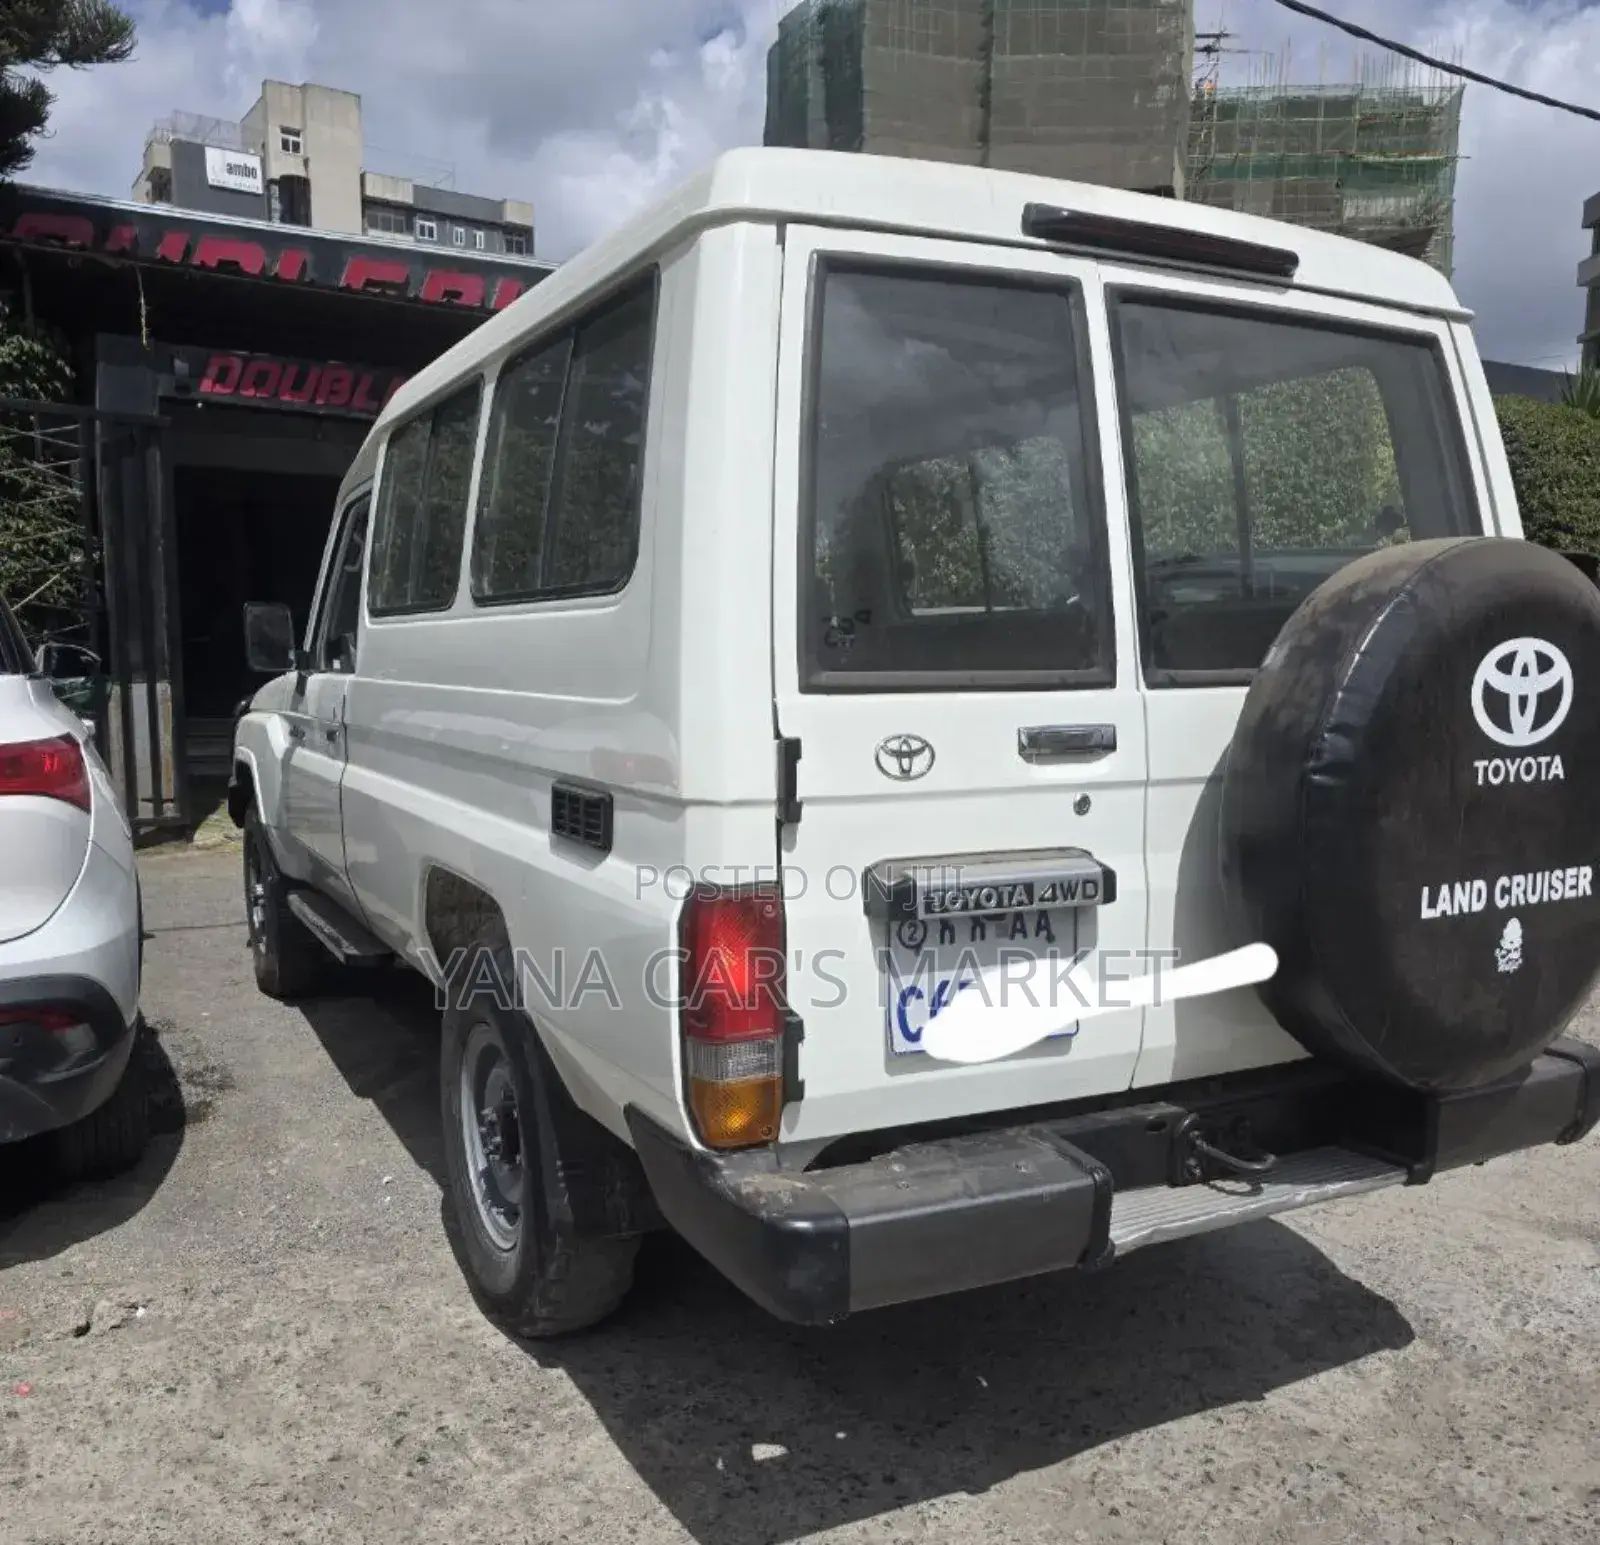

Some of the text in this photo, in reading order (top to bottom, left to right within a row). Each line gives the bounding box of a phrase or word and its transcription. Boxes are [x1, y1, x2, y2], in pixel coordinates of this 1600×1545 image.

[199, 355, 408, 411] DOUBL
[1473, 755, 1564, 785] TOYOTA
[930, 878, 1100, 912] TOYOTA 4WD
[1421, 865, 1593, 919] LAND CRUISER
